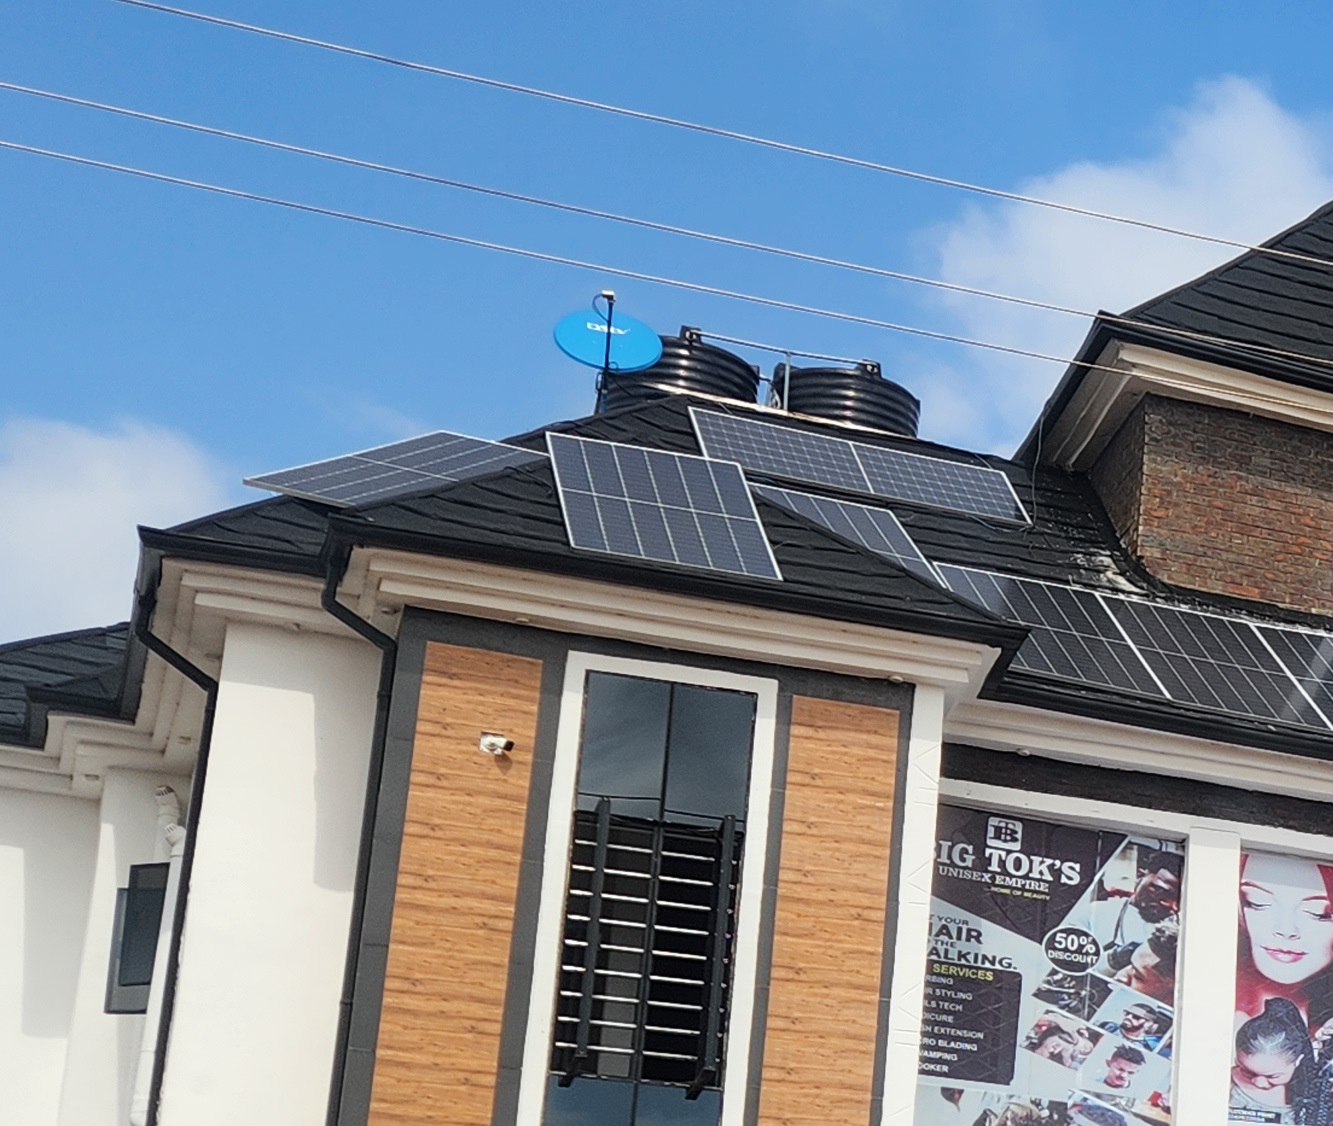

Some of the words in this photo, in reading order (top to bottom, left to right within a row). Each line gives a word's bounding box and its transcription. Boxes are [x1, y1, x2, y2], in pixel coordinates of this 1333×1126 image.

[935, 840, 976, 869] IG
[985, 847, 1081, 886] TOK'S
[938, 866, 992, 883] UNISEX
[994, 874, 1049, 892] EMPIRE
[937, 915, 969, 926] YOUR
[934, 938, 957, 949] THE
[1054, 932, 1096, 953] 50%
[927, 946, 1018, 970] ALKING.
[932, 963, 994, 981] SERVICES
[935, 989, 973, 1000] STYLING
[938, 1001, 963, 1011] TECH
[934, 1027, 984, 1039] EXTENSION
